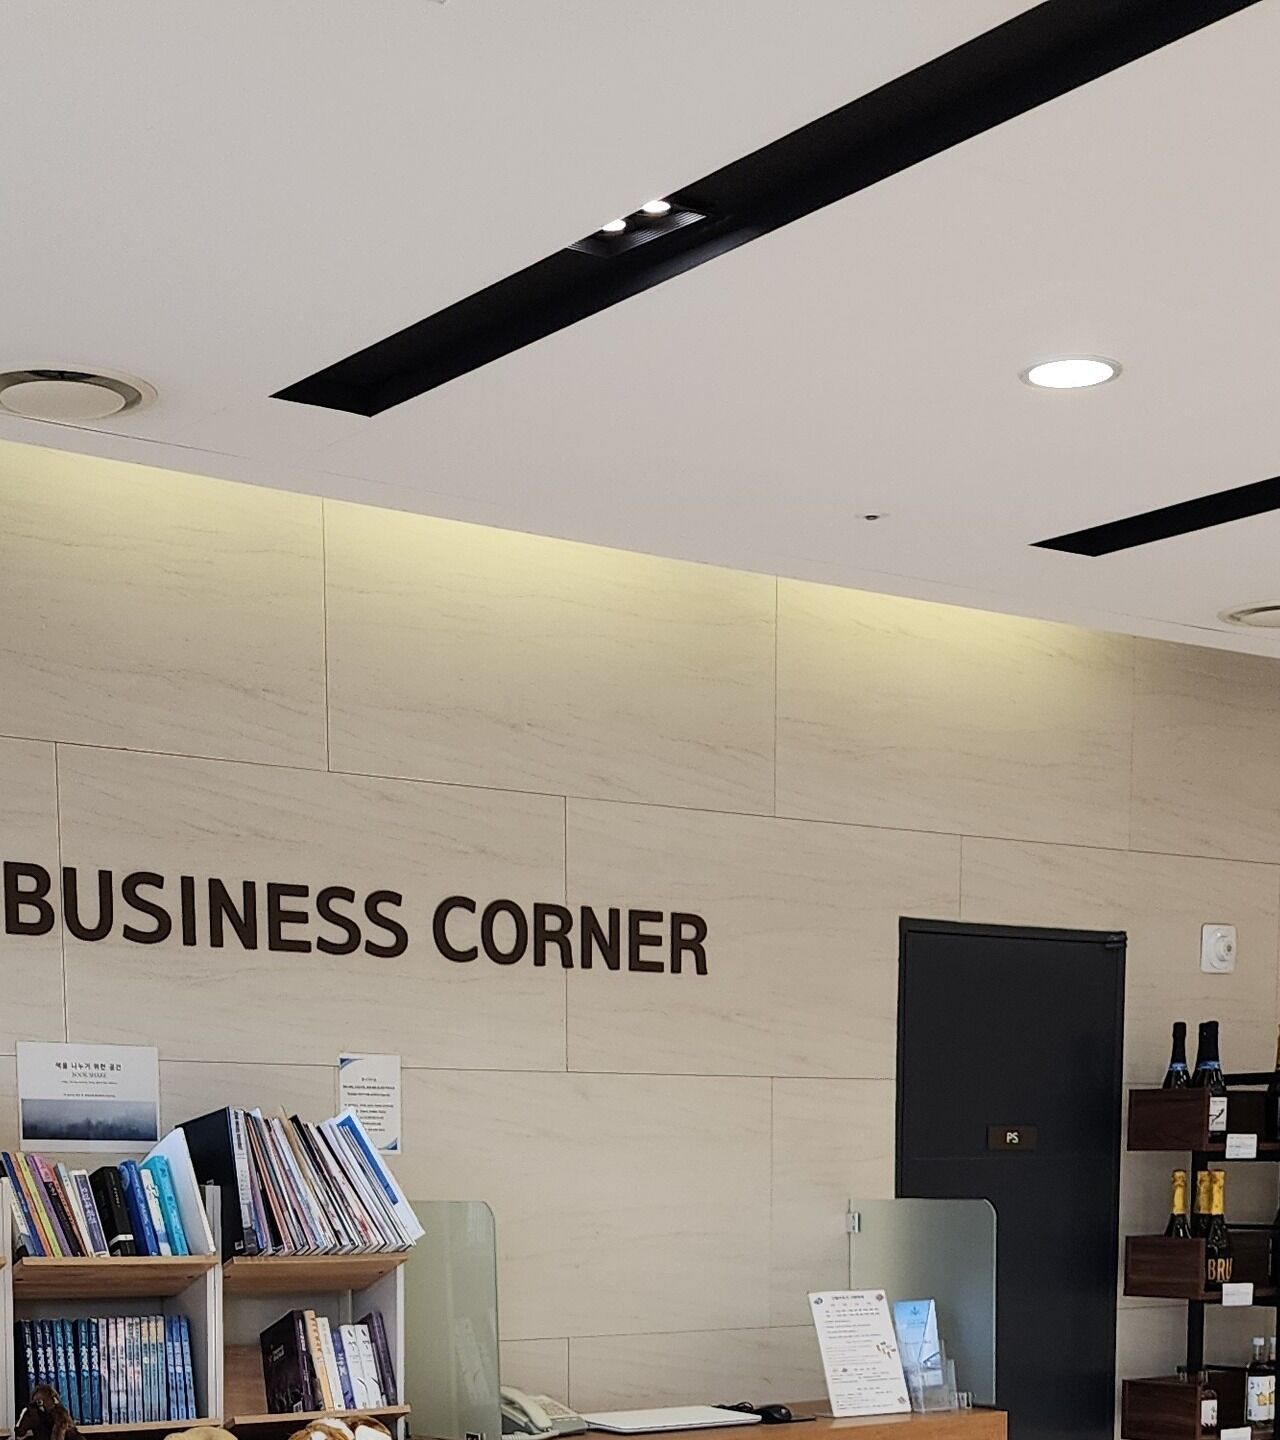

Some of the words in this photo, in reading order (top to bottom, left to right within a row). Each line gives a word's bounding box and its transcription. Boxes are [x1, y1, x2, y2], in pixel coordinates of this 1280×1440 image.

[1, 860, 410, 960] BUSINESS
[431, 895, 709, 977] CORNER
[1005, 1131, 1020, 1145] PS
